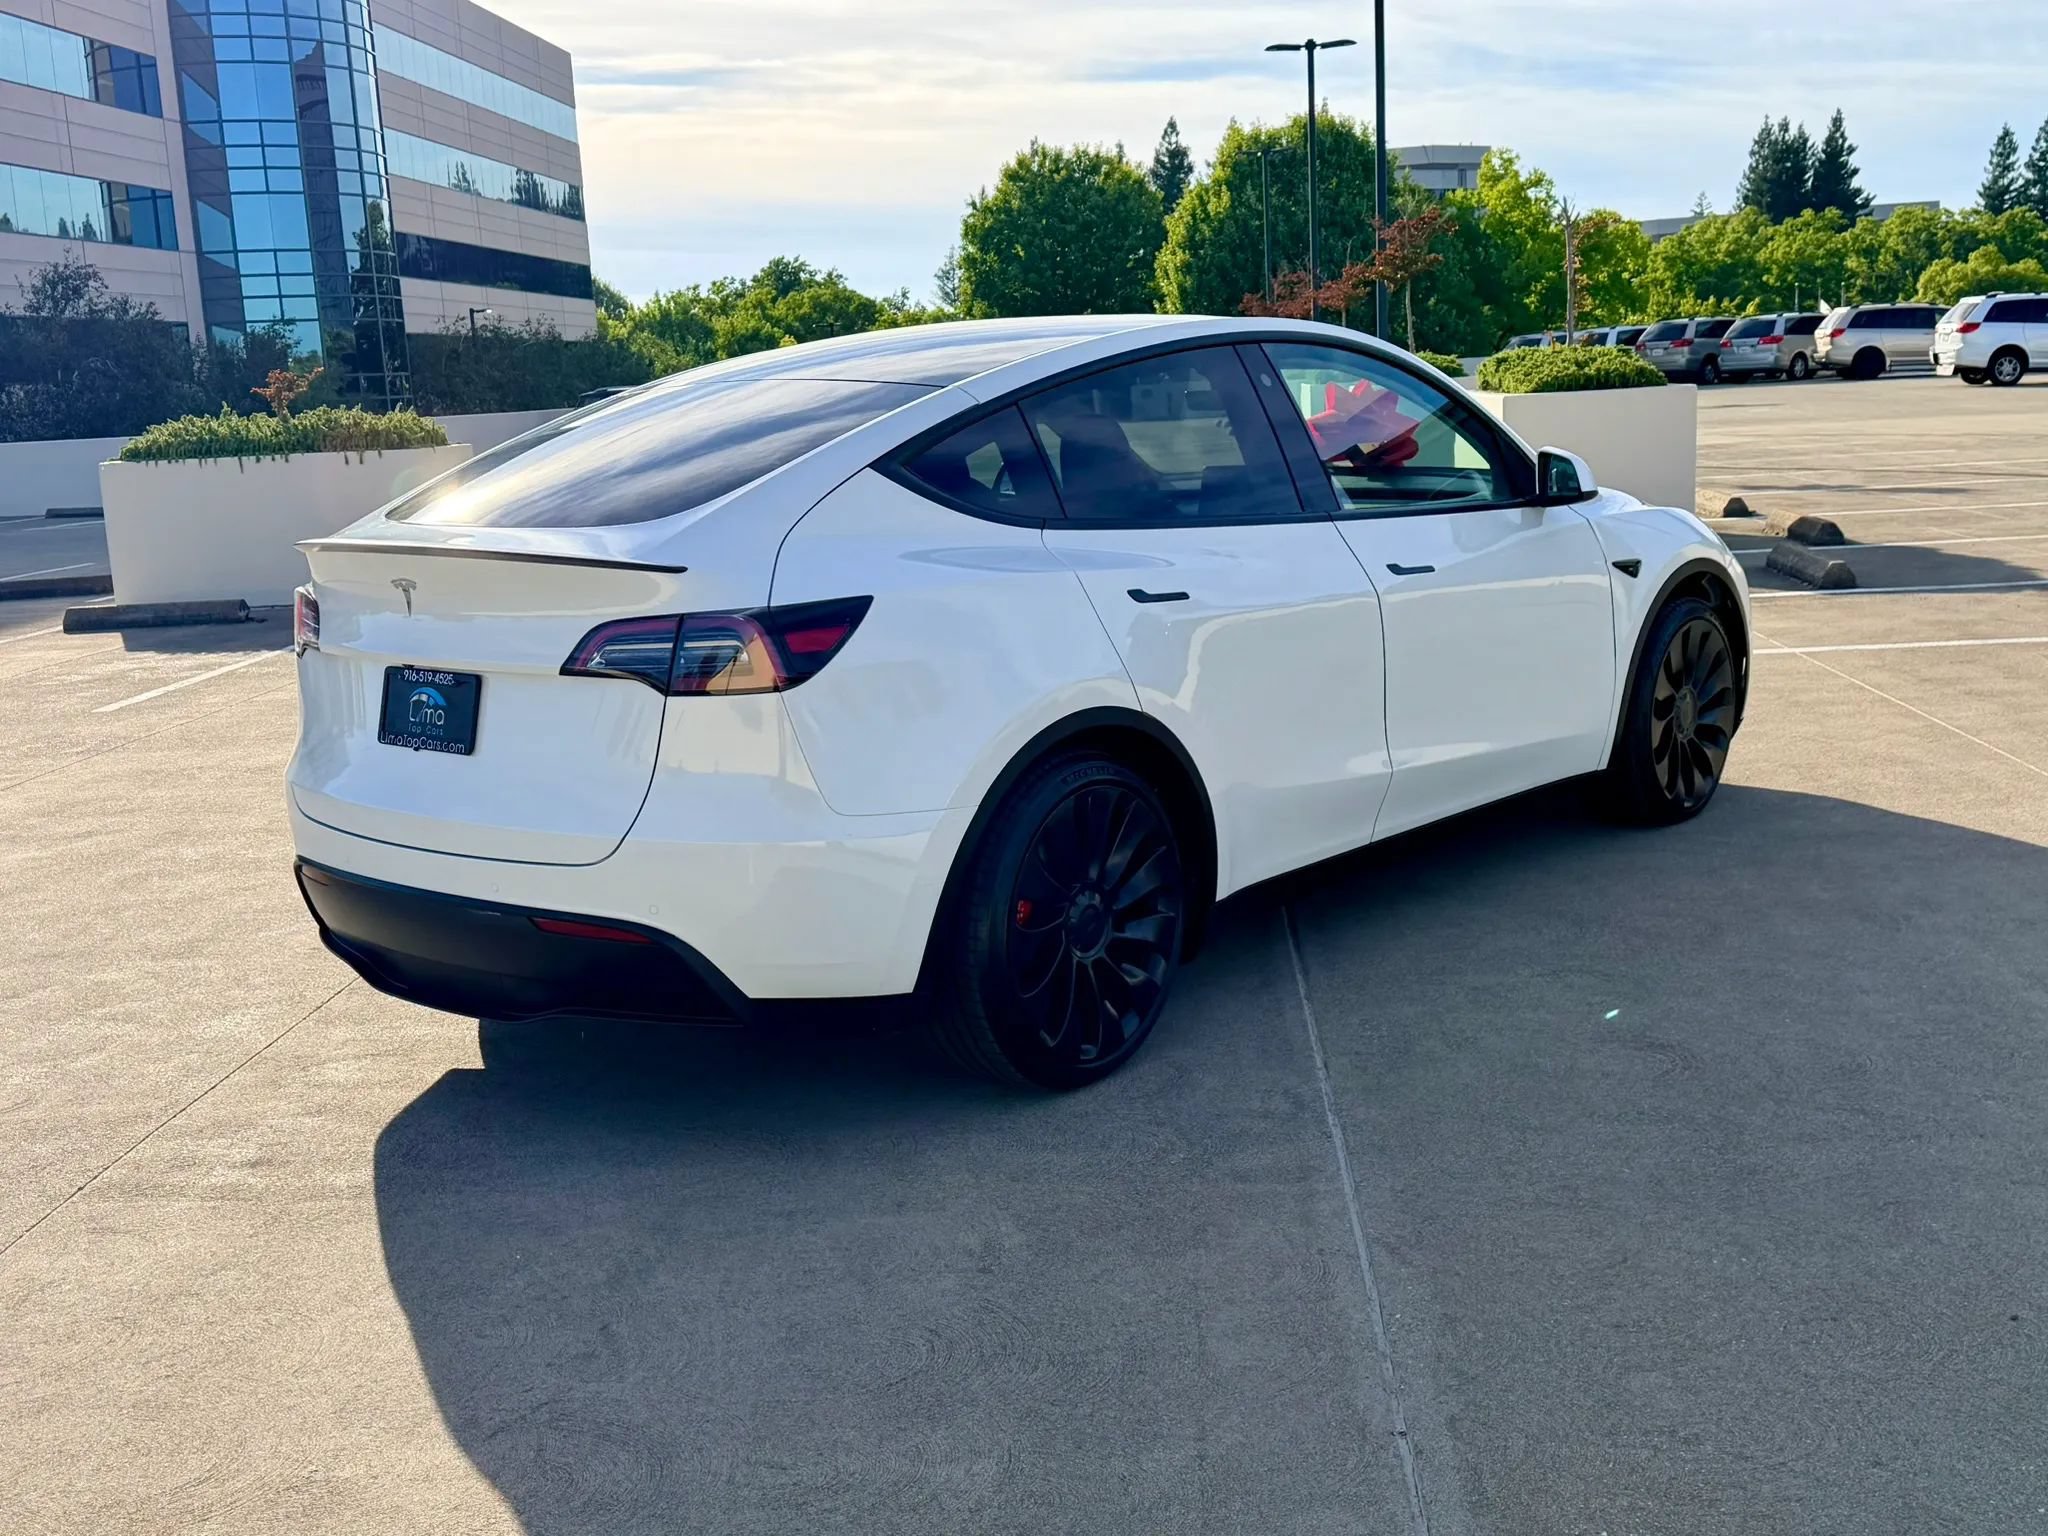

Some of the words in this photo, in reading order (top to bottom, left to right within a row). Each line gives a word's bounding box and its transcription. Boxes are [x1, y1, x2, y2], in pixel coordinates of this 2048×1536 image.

[403, 669, 454, 685] 916-519-4525
[408, 723, 422, 733] Top
[426, 725, 443, 736] Cars
